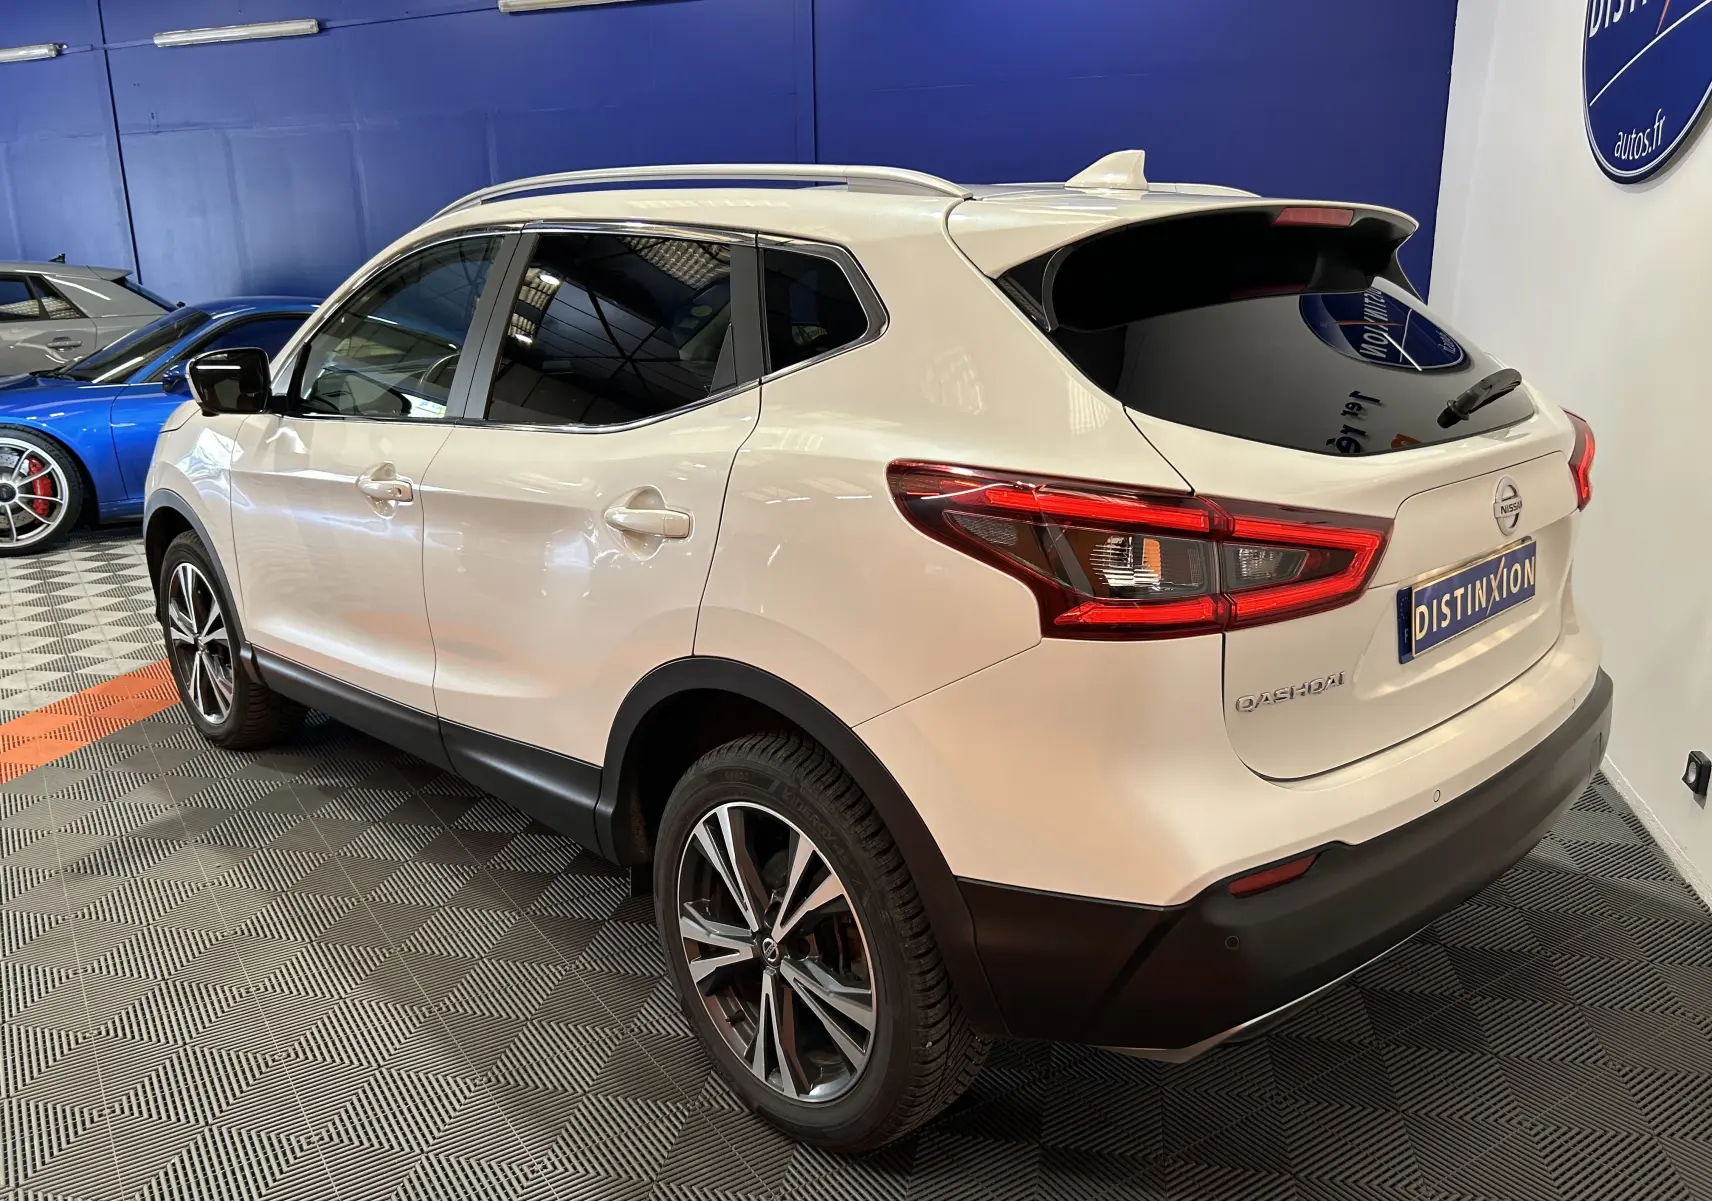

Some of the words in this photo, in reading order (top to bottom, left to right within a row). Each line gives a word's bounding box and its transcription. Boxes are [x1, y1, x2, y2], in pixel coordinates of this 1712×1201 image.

[1614, 108, 1666, 160] autos.fr
[1500, 500, 1523, 515] NISSAN
[1415, 556, 1536, 640] DISTINXION
[1236, 671, 1346, 712] QASHQAI
